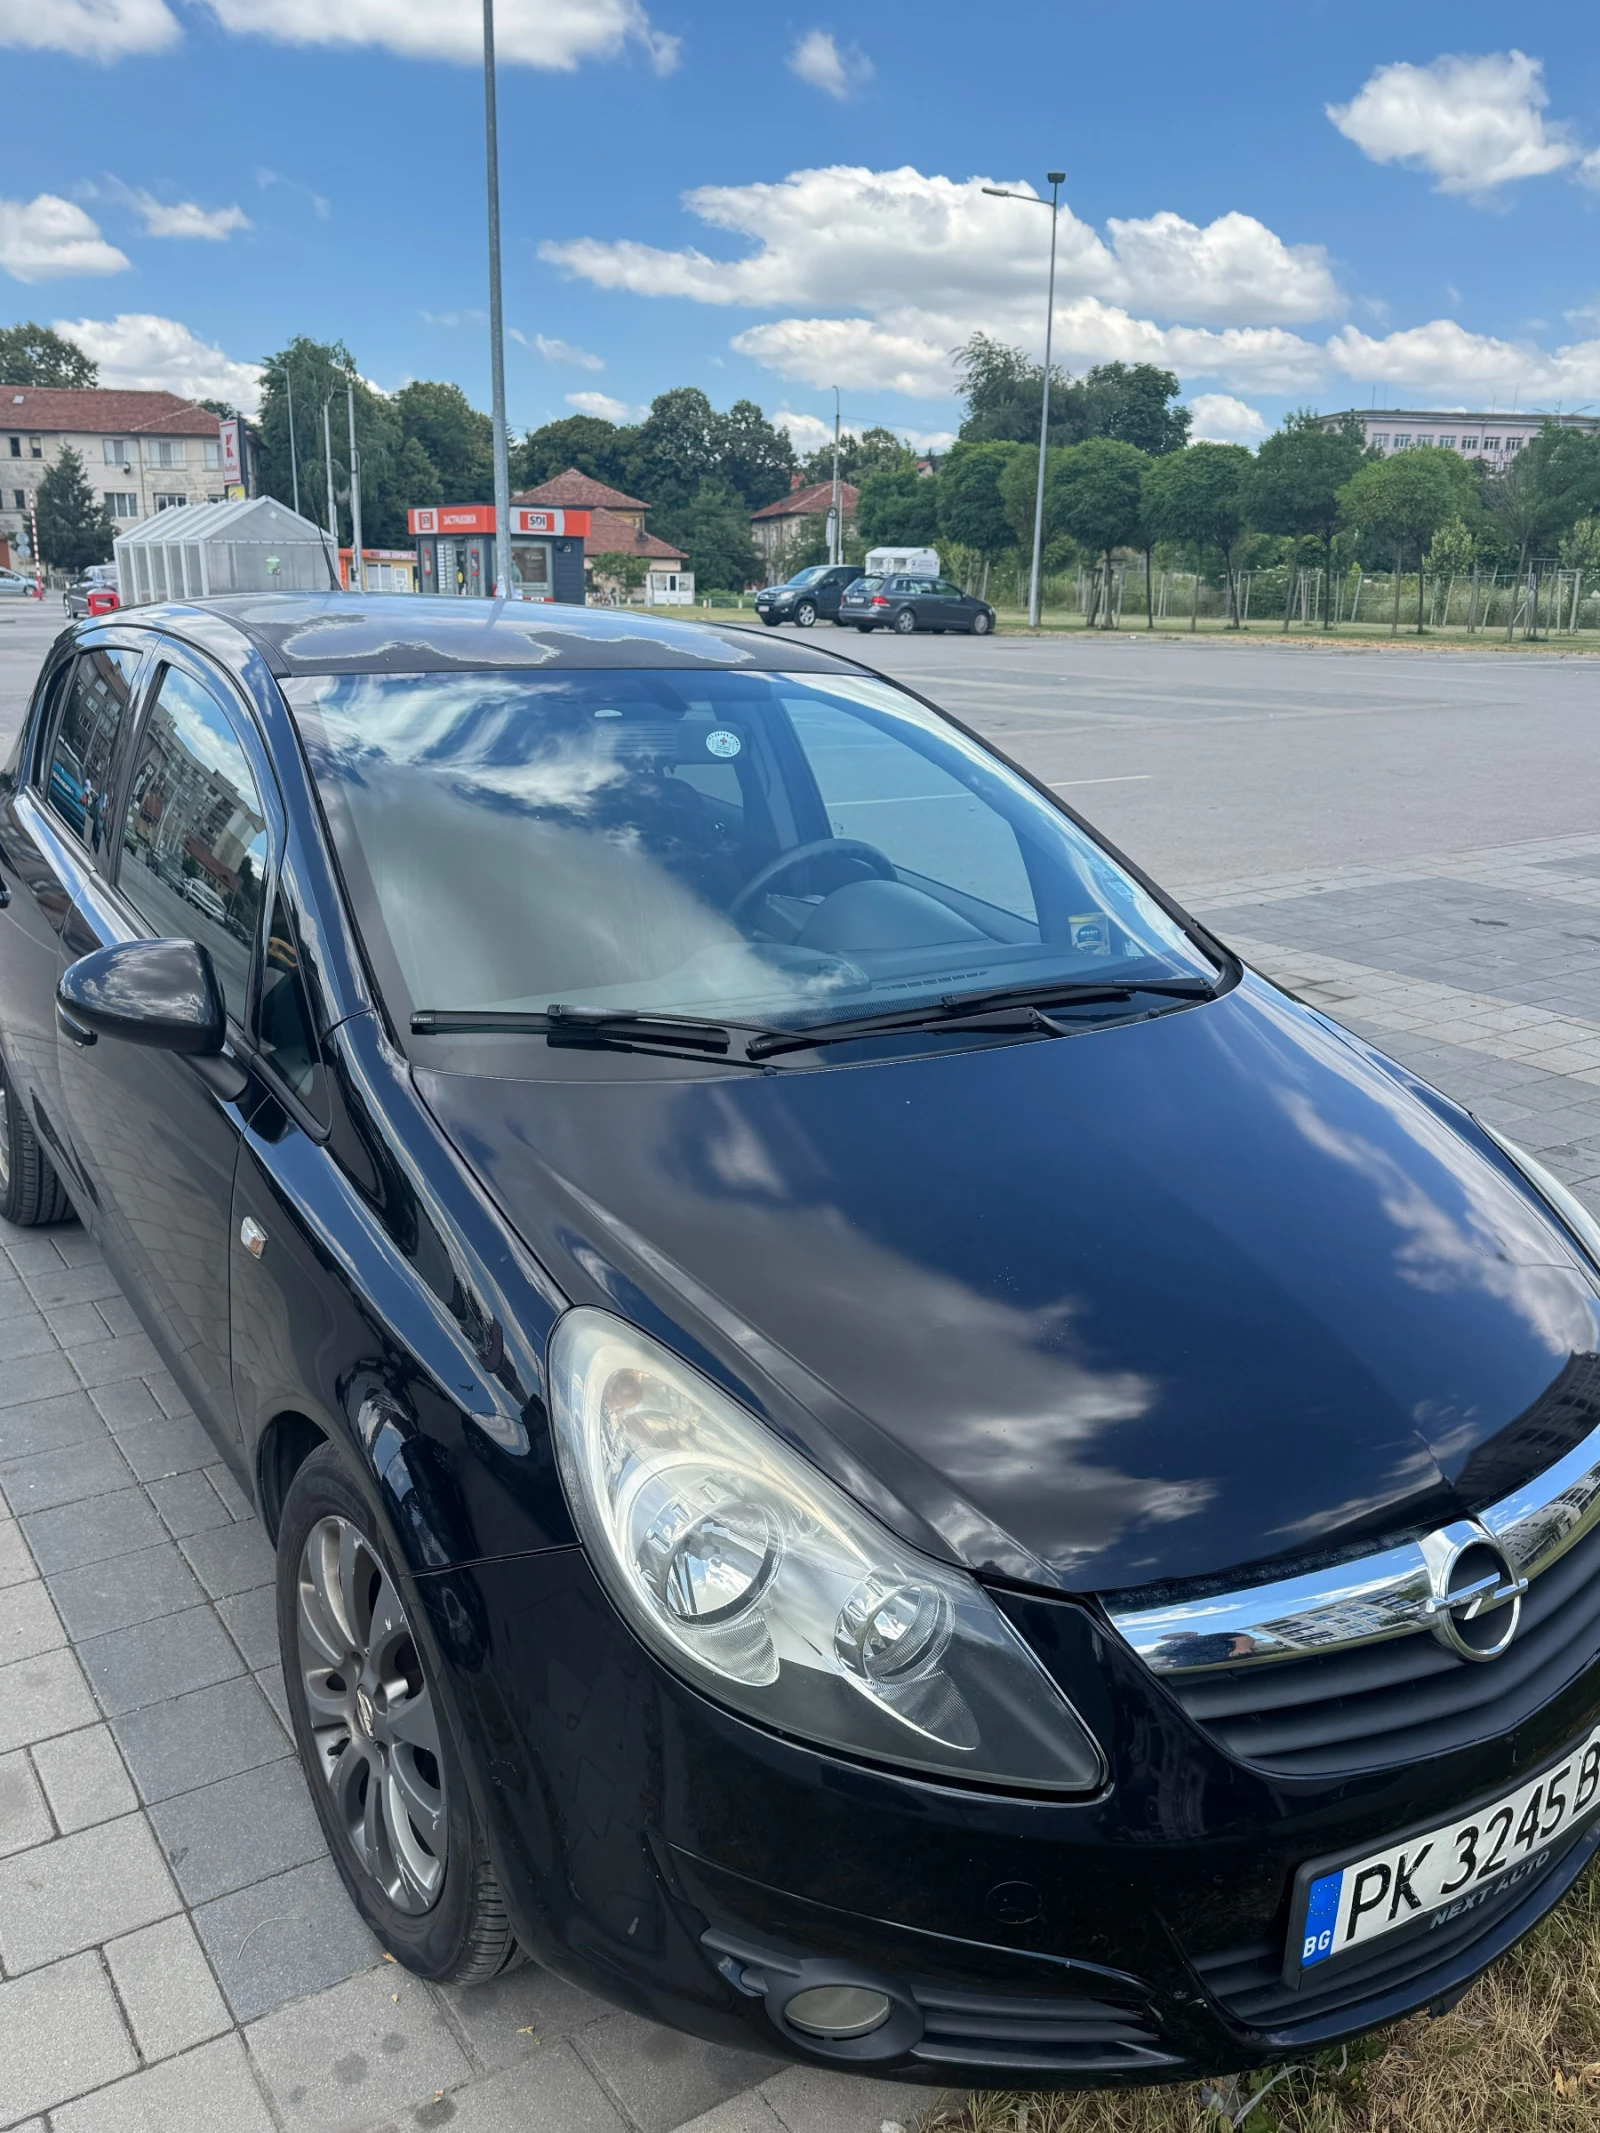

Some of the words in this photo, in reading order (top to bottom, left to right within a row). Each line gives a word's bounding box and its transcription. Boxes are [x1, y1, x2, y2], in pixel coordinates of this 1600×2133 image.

[530, 515, 545, 525] SDI
[1345, 1842, 1434, 1941] PK
[1430, 1886, 1492, 1929] NEXT
[1494, 1851, 1550, 1895] AUTO
[1303, 1930, 1331, 1959] BG
